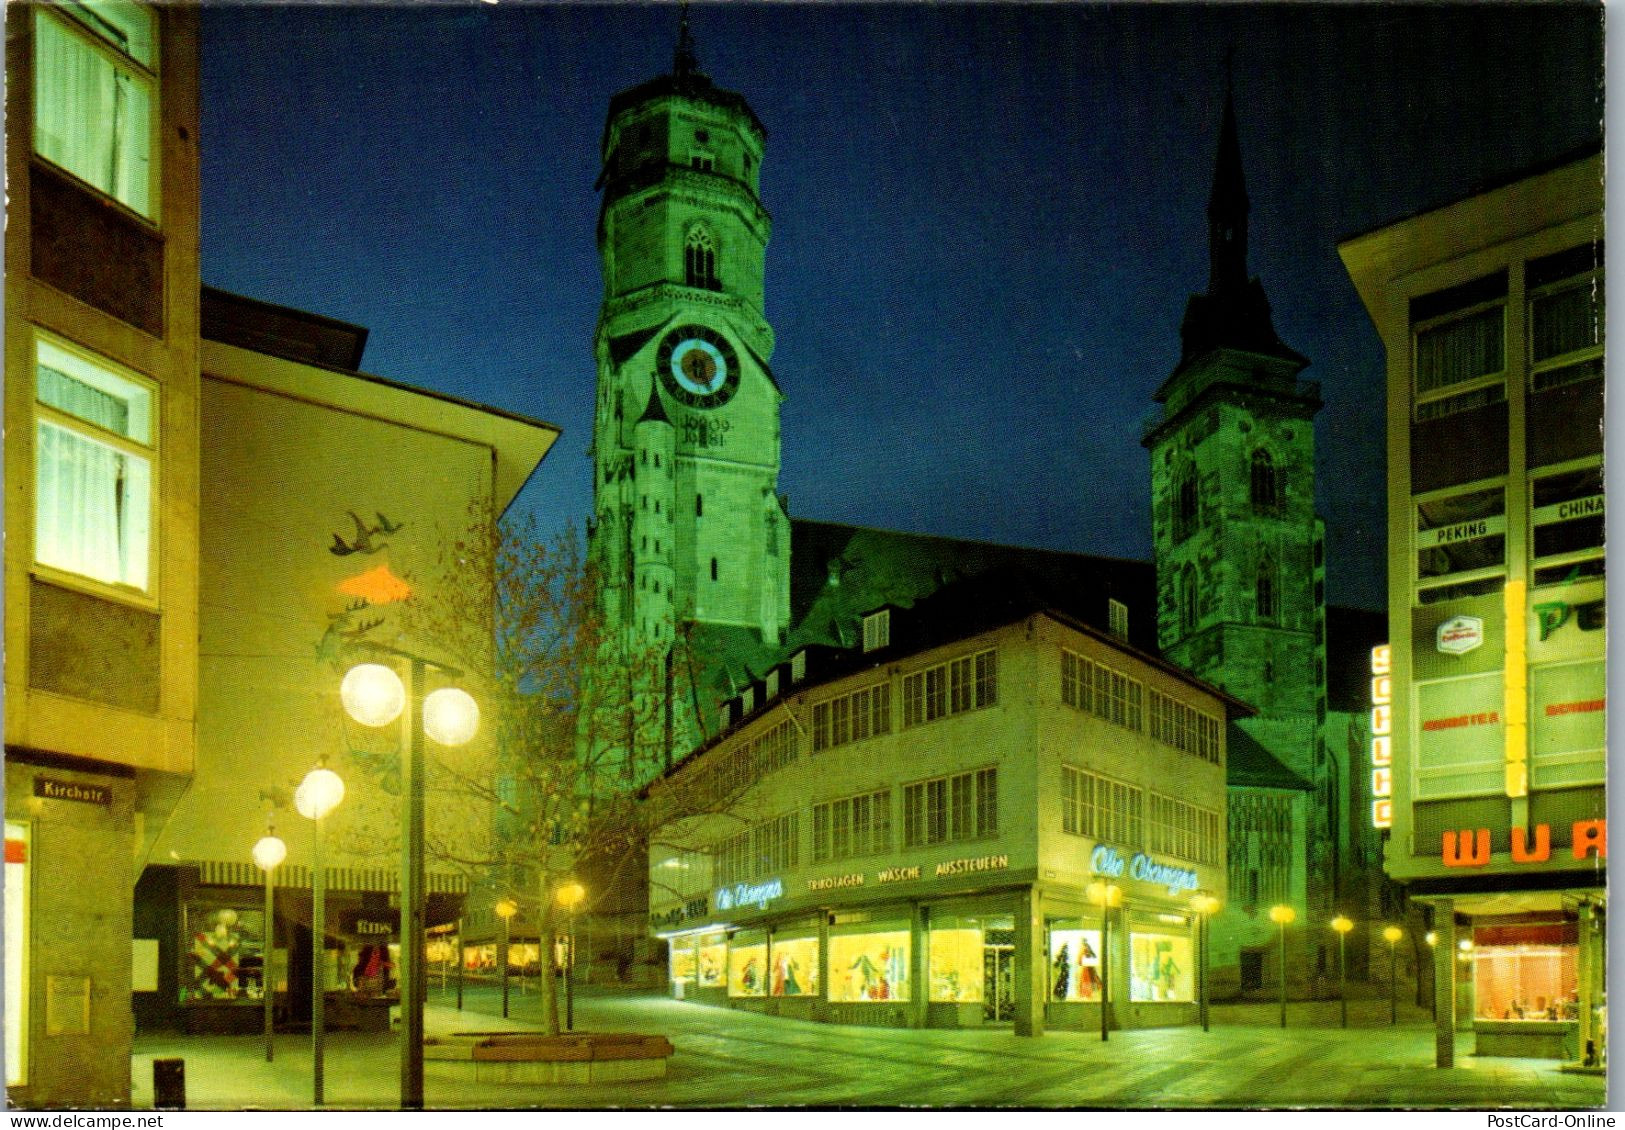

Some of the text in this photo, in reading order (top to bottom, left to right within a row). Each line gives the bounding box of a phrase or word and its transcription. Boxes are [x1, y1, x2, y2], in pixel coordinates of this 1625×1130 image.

[1437, 520, 1488, 542] PEKING
[807, 855, 1009, 891] TRIKOTAGEN WÄSCHE AUSSTEUERN
